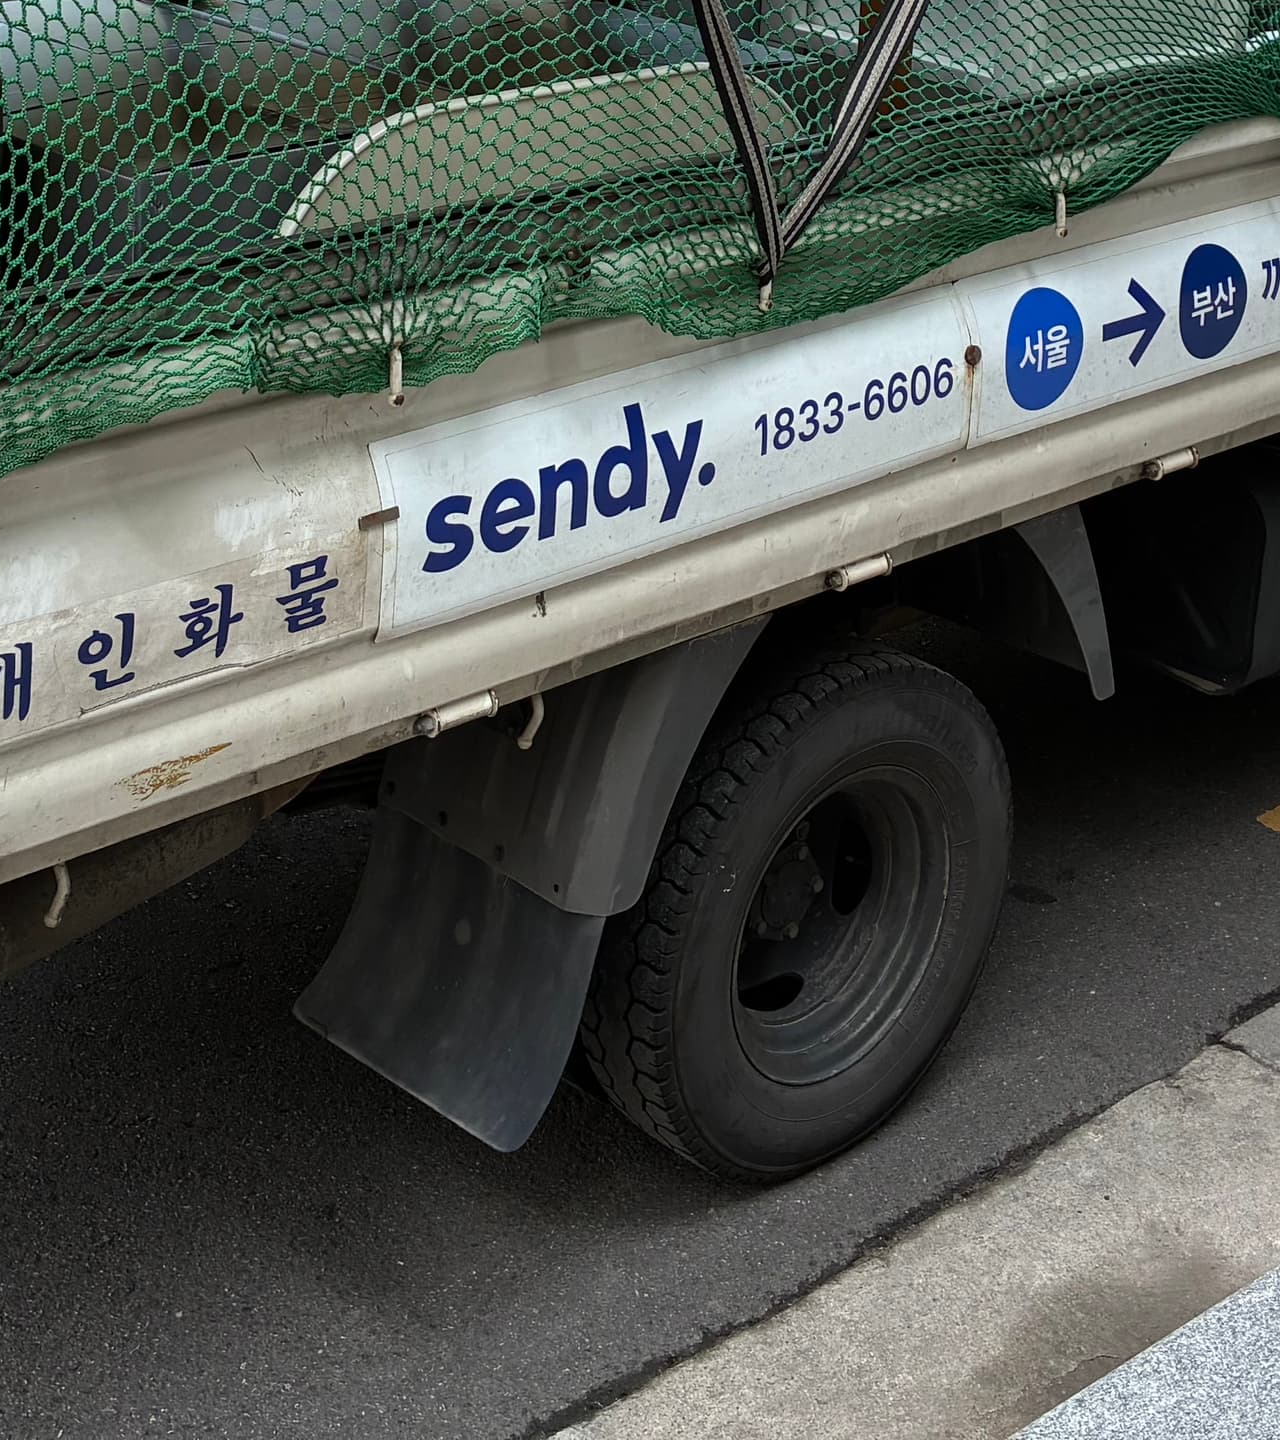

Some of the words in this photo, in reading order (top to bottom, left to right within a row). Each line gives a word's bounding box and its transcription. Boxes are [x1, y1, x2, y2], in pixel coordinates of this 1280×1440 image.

[1018, 324, 1071, 374] 서울
[1190, 277, 1237, 327] 부산
[421, 403, 717, 574] sendy.
[753, 357, 954, 456] 1833-6606
